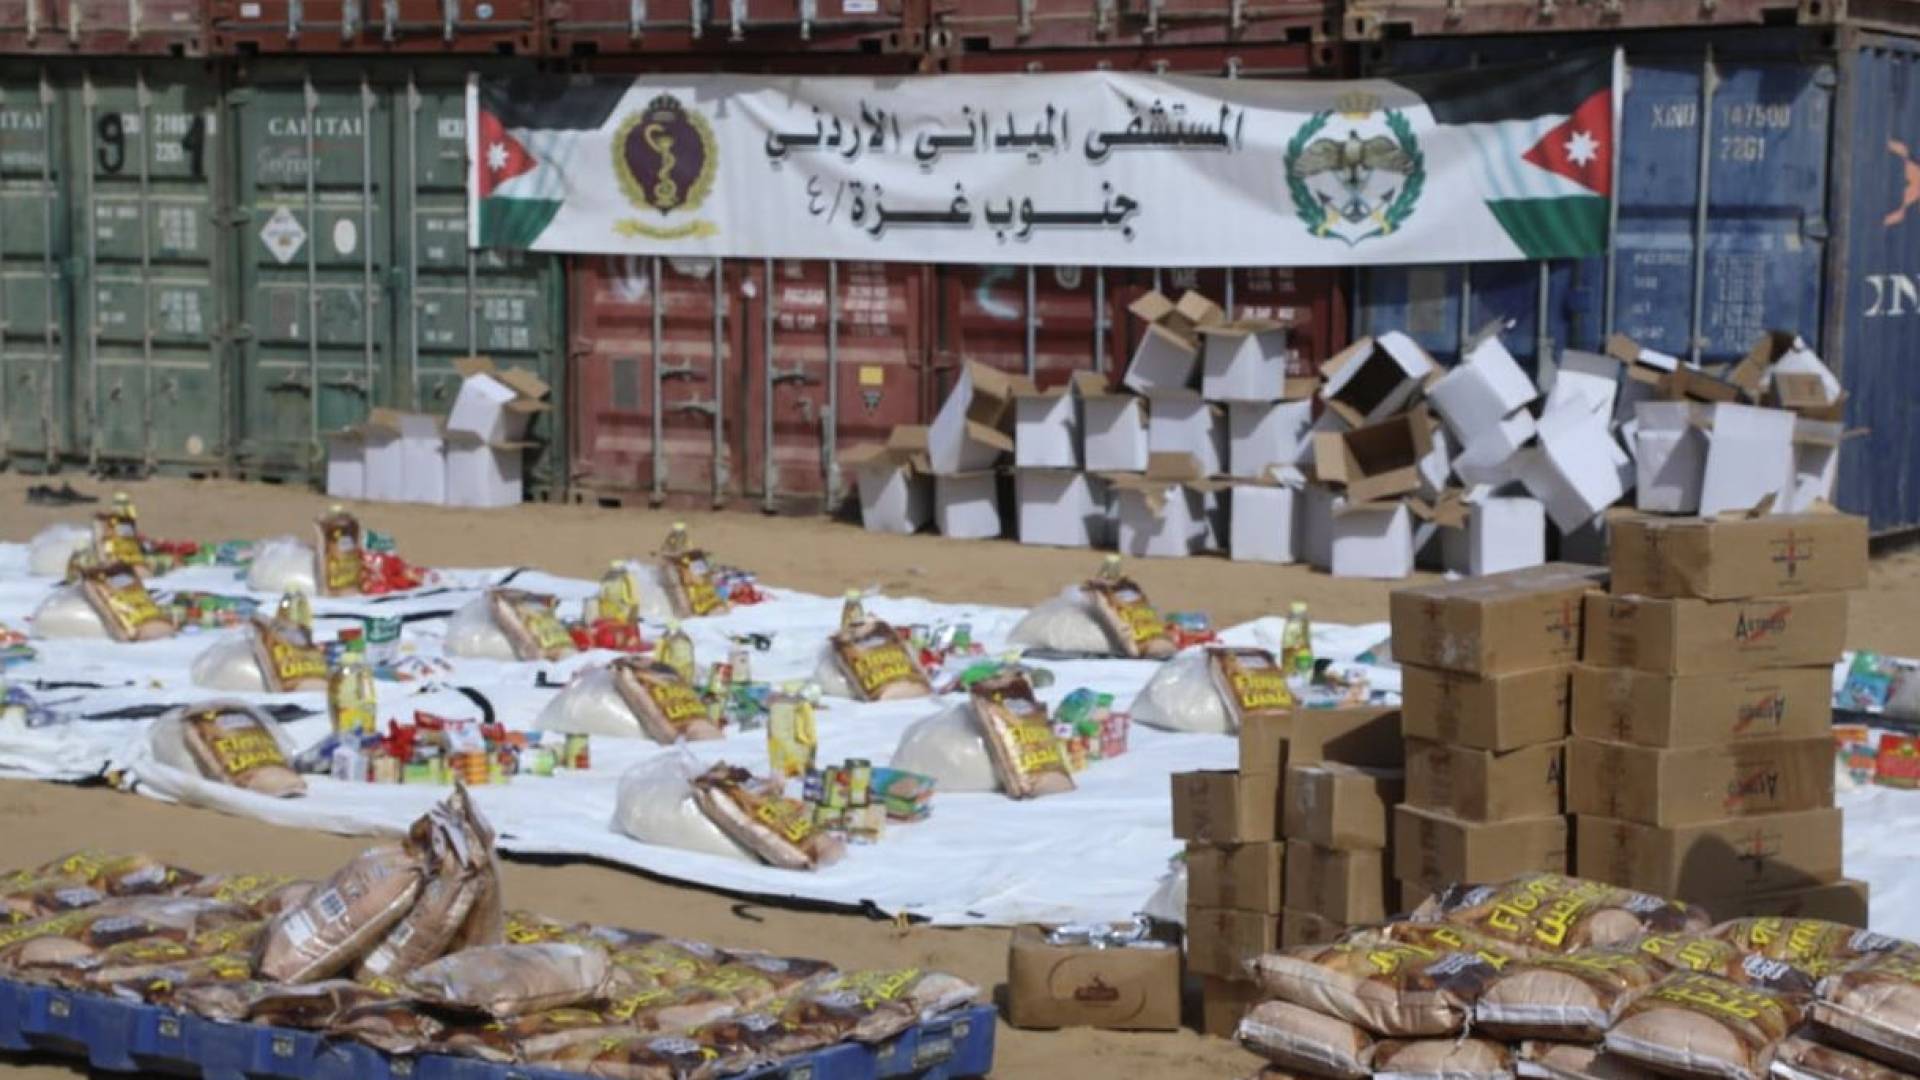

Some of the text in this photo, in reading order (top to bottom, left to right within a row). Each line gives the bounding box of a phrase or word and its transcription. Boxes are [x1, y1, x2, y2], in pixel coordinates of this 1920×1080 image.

[98, 113, 125, 174] 9
[914, 102, 1069, 170] الميداني
[1085, 98, 1245, 161] المستشفى
[983, 179, 1140, 240] جنوب
